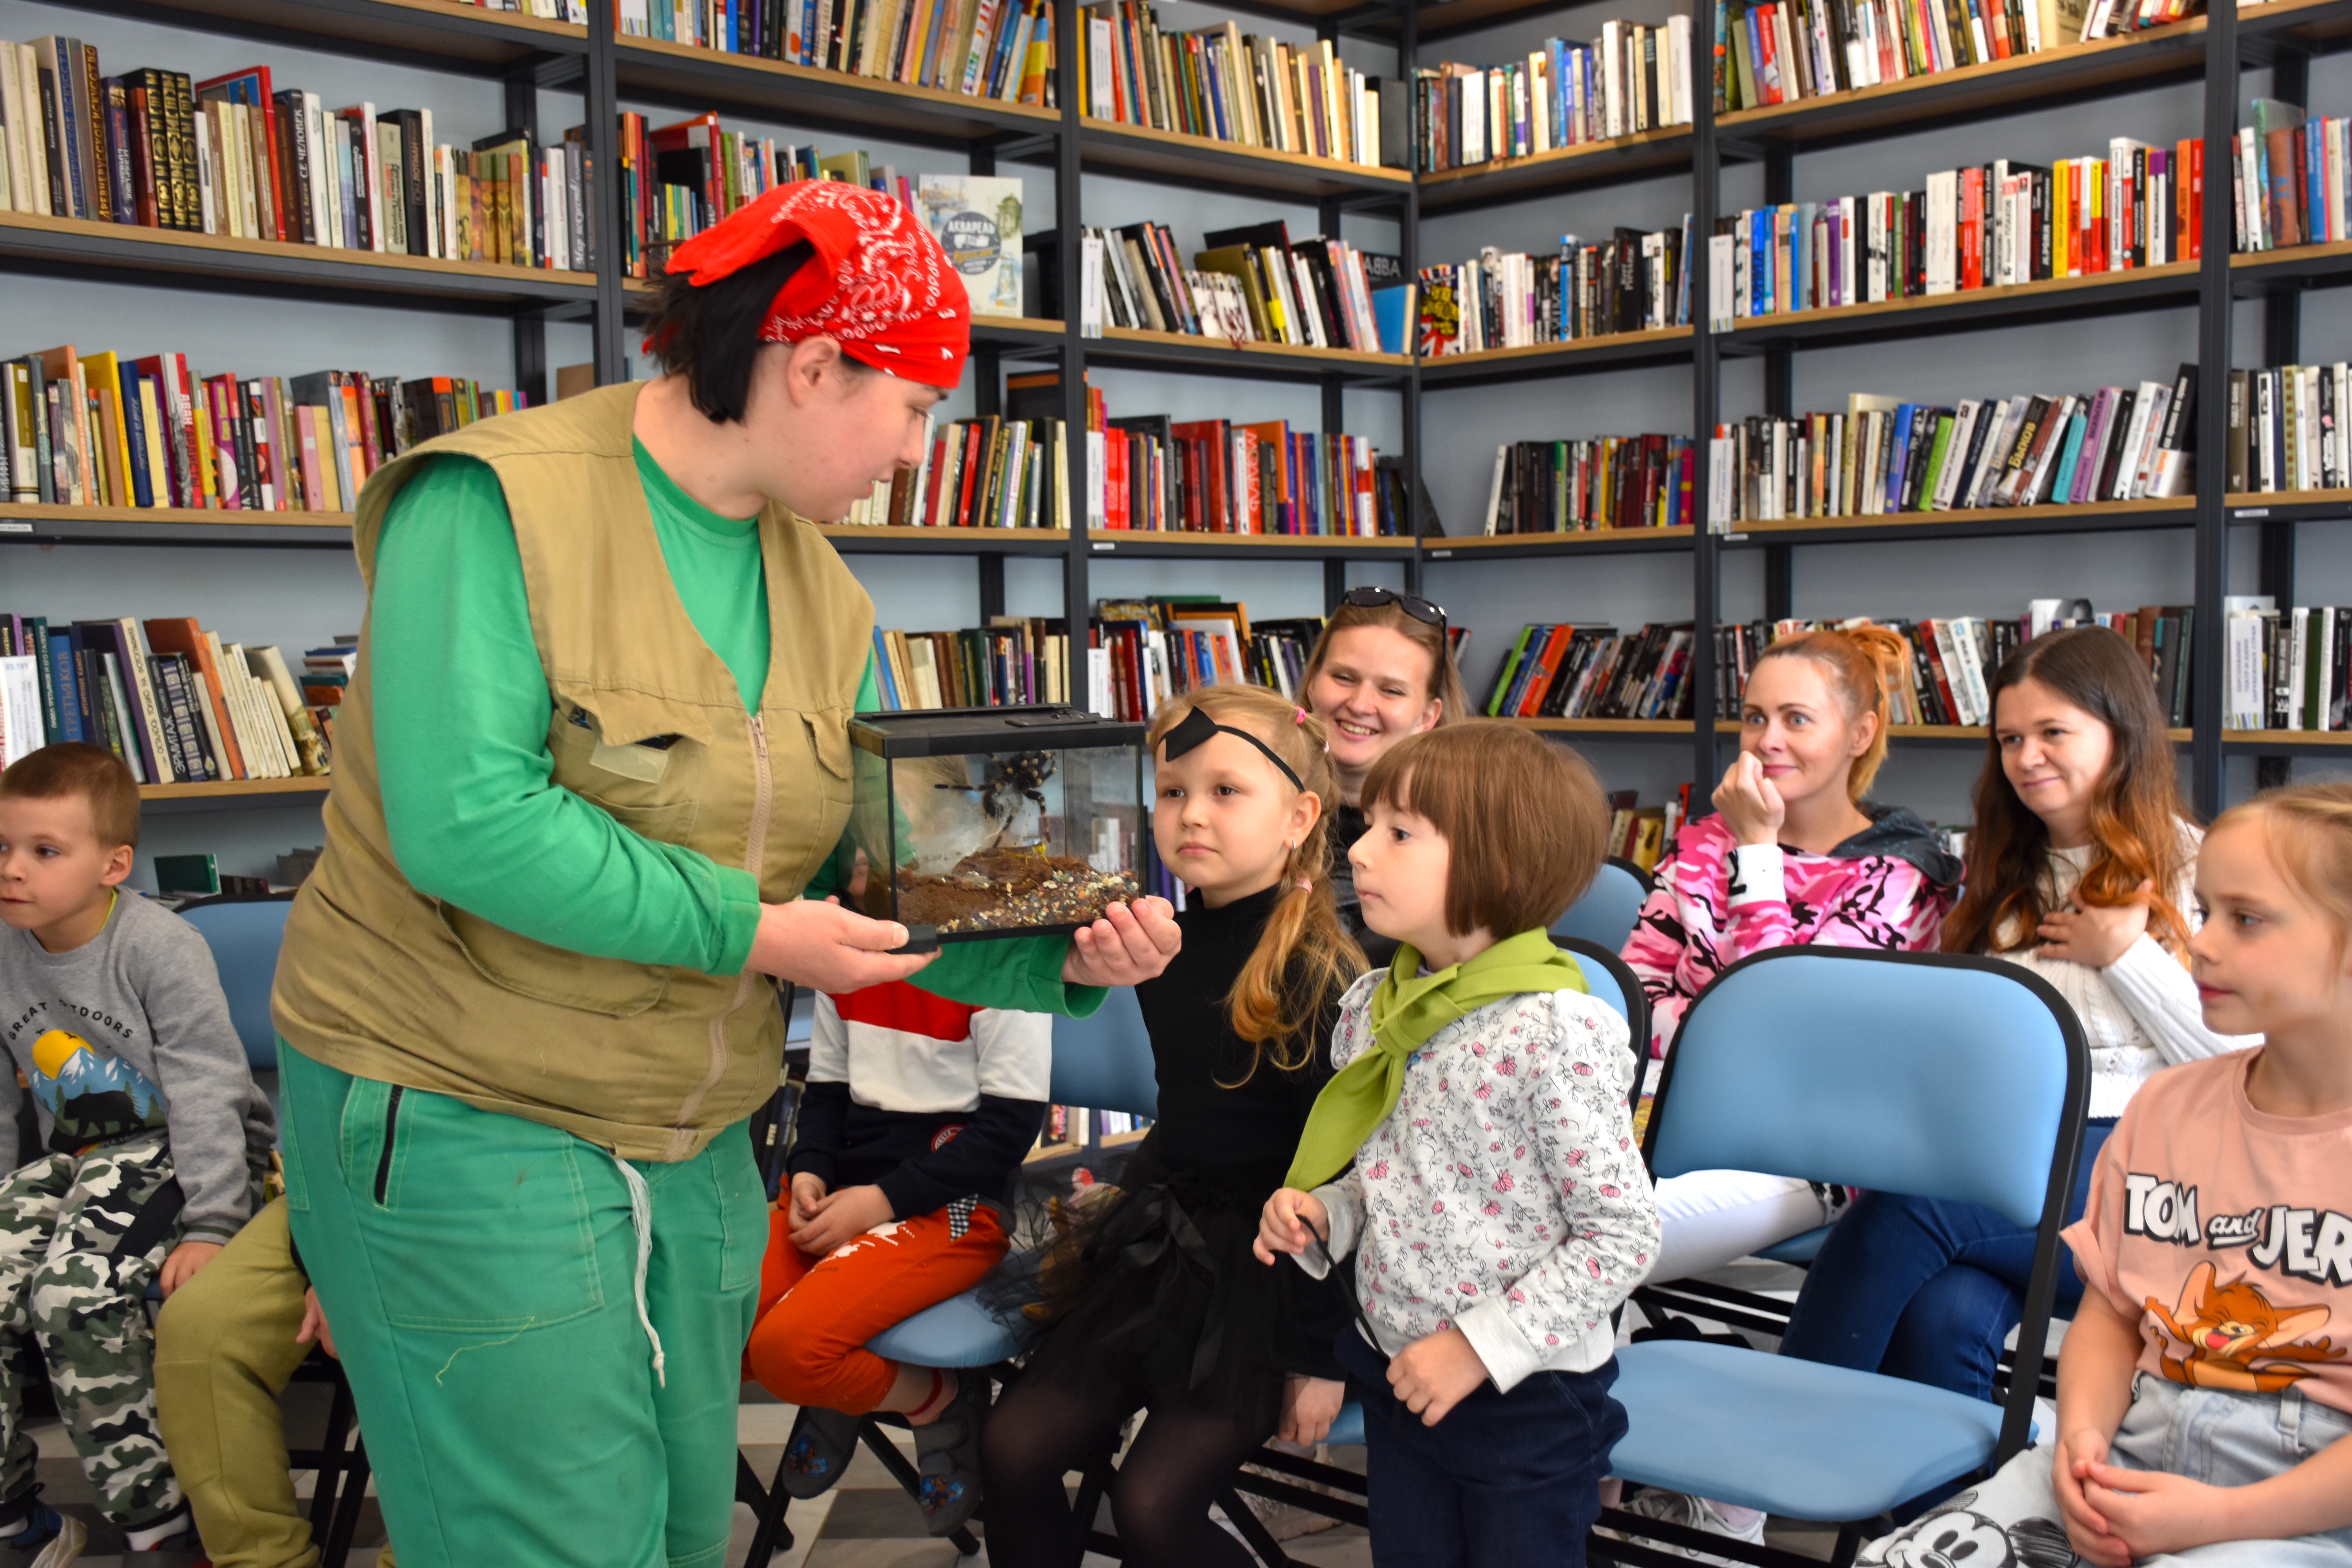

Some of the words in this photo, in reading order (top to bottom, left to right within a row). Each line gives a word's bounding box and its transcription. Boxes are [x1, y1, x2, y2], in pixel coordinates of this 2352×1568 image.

[58, 39, 74, 113] ИСКУССТВО
[85, 45, 101, 119] ИСКУССТВО
[66, 116, 85, 216] ДРЕВНЕРУССКОЕ
[93, 122, 111, 220] ДРЕВНЕРУССКОЕ
[298, 163, 309, 178] СЕ
[948, 220, 995, 234] АКВАРЕЛЬ
[2008, 421, 2037, 469] Быков
[127, 626, 145, 674] ФОТОГРАФИЯХ
[57, 652, 80, 735] ТРЕТЬЯКОВ
[140, 677, 148, 687] НА
[143, 690, 154, 716] ТОЛЬКО
[151, 719, 164, 754] ОСТАЛОСЬ
[163, 715, 186, 774] ЭРМИТАЖ
[9, 1002, 47, 1040] GREAT
[59, 999, 133, 1038] OTDOORS
[2124, 1172, 2201, 1247] TOM
[2205, 1207, 2265, 1250] and
[2246, 1205, 2352, 1288] JER
